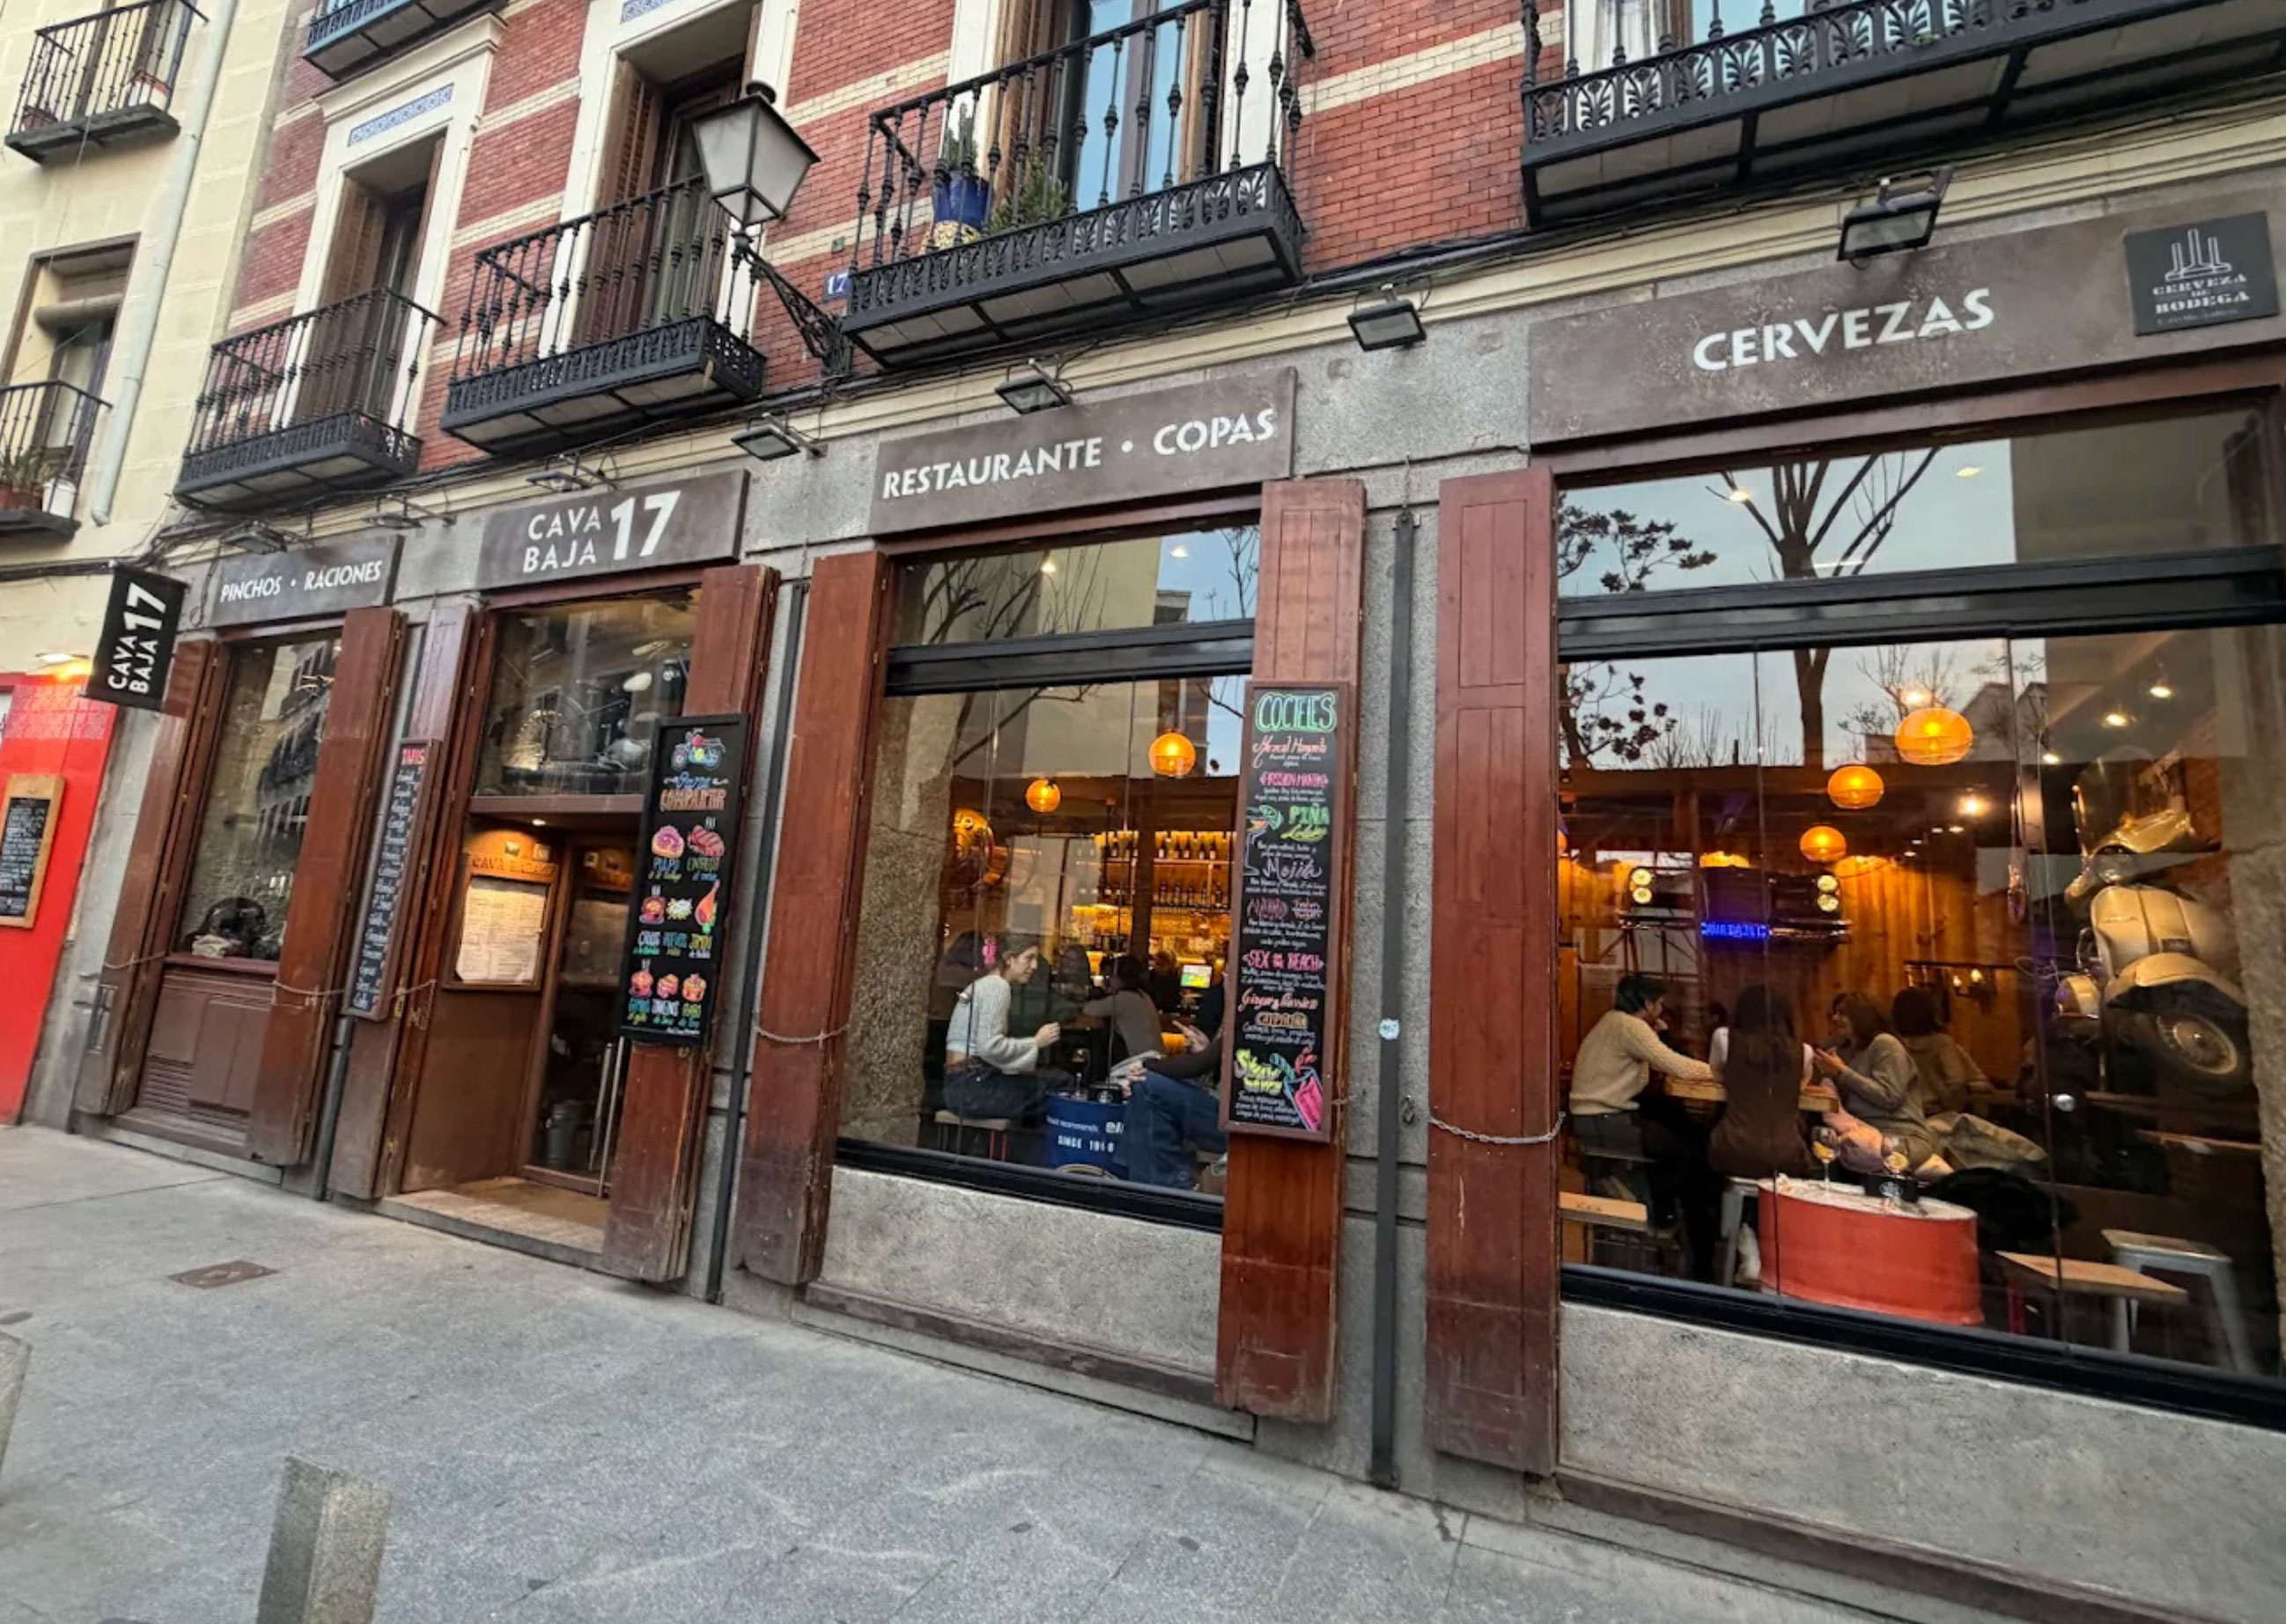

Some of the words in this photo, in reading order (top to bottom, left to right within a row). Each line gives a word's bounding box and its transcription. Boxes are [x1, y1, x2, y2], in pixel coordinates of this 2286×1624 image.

[828, 272, 849, 294] 17
[2152, 274, 2246, 295] CERVEZA
[2156, 292, 2249, 314] BODEGA
[1692, 288, 1995, 372] CERVEZAS
[882, 436, 1102, 499] RESTAURANTE
[1153, 408, 1275, 455] COPAS
[528, 506, 601, 541] CAVA
[610, 490, 682, 561] 17
[523, 539, 597, 572] BAJA
[220, 575, 283, 602] PINCHOS
[304, 560, 383, 591] RACIONES
[122, 581, 167, 631] 17
[107, 635, 137, 690] CAVA
[129, 639, 159, 694] BAJA
[1257, 693, 1336, 732] COCTELES
